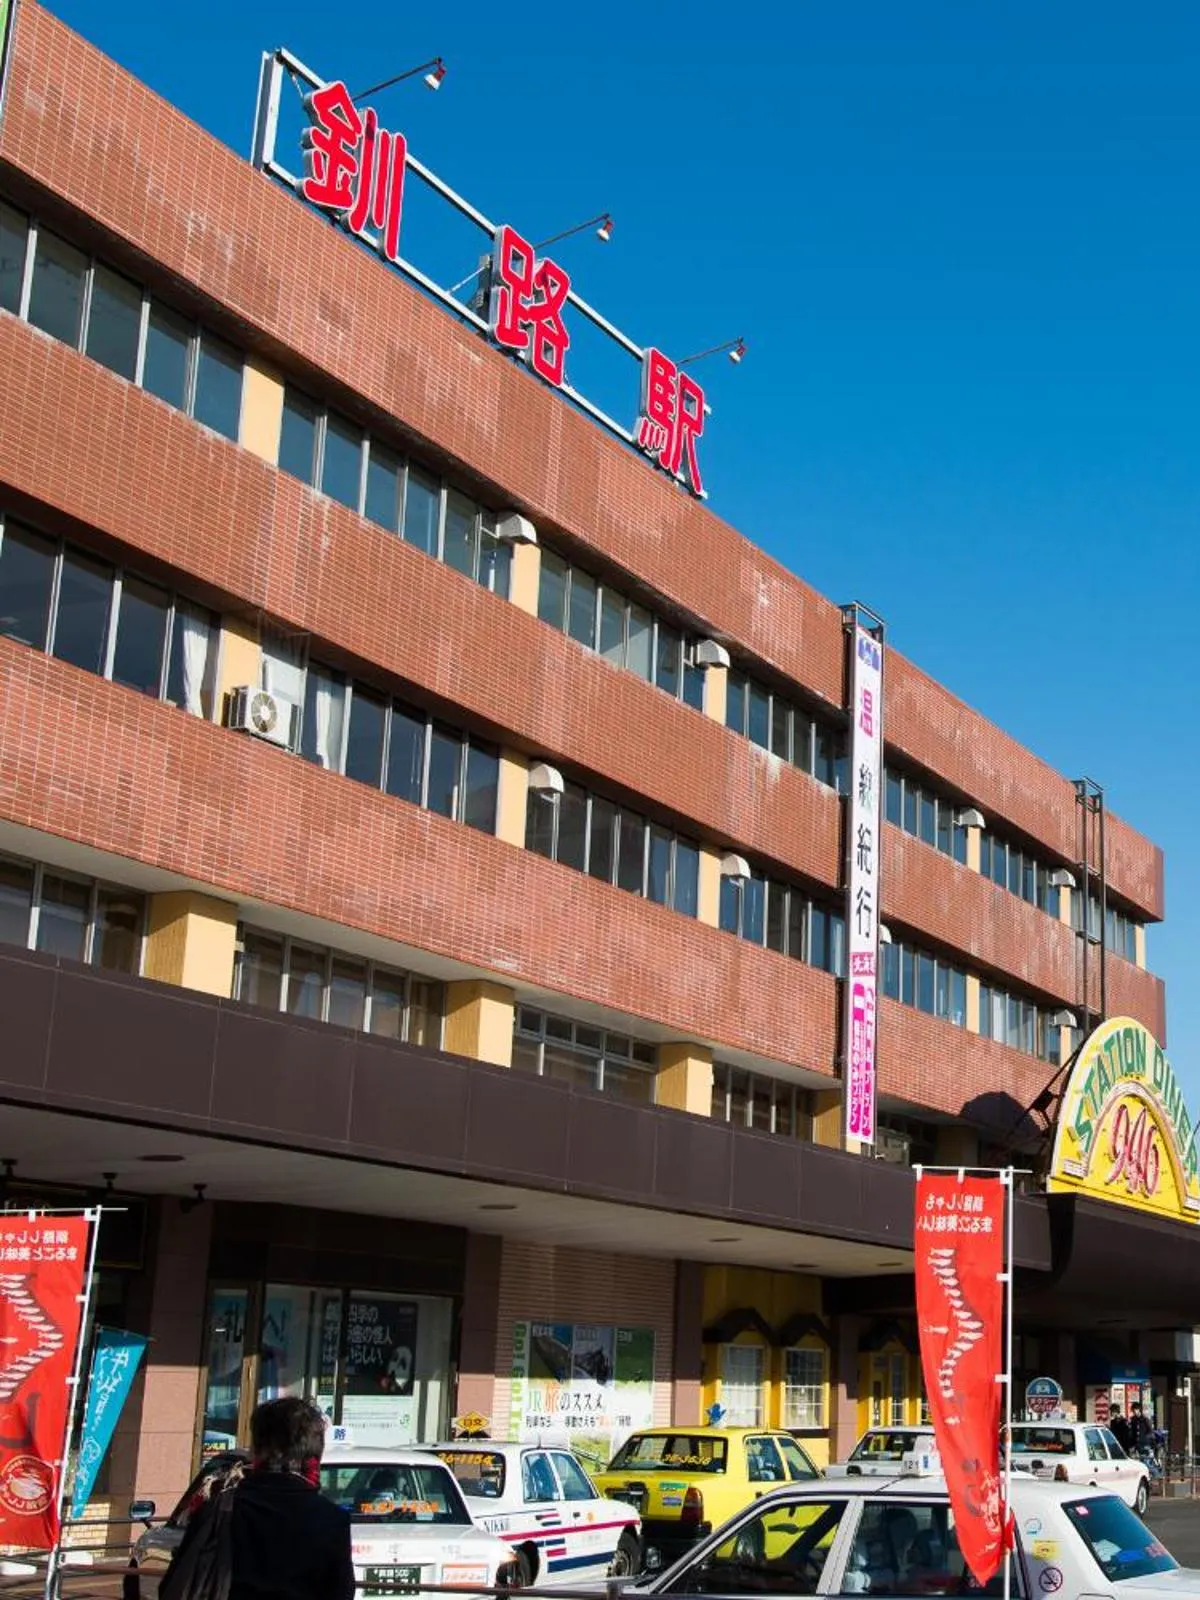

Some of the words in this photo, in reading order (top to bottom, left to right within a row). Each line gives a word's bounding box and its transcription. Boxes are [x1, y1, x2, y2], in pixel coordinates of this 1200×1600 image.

[300, 81, 706, 496] 釧路駅
[1075, 1027, 1146, 1152] STATION
[1153, 1044, 1198, 1185] DINER
[1105, 1104, 1160, 1199] 946
